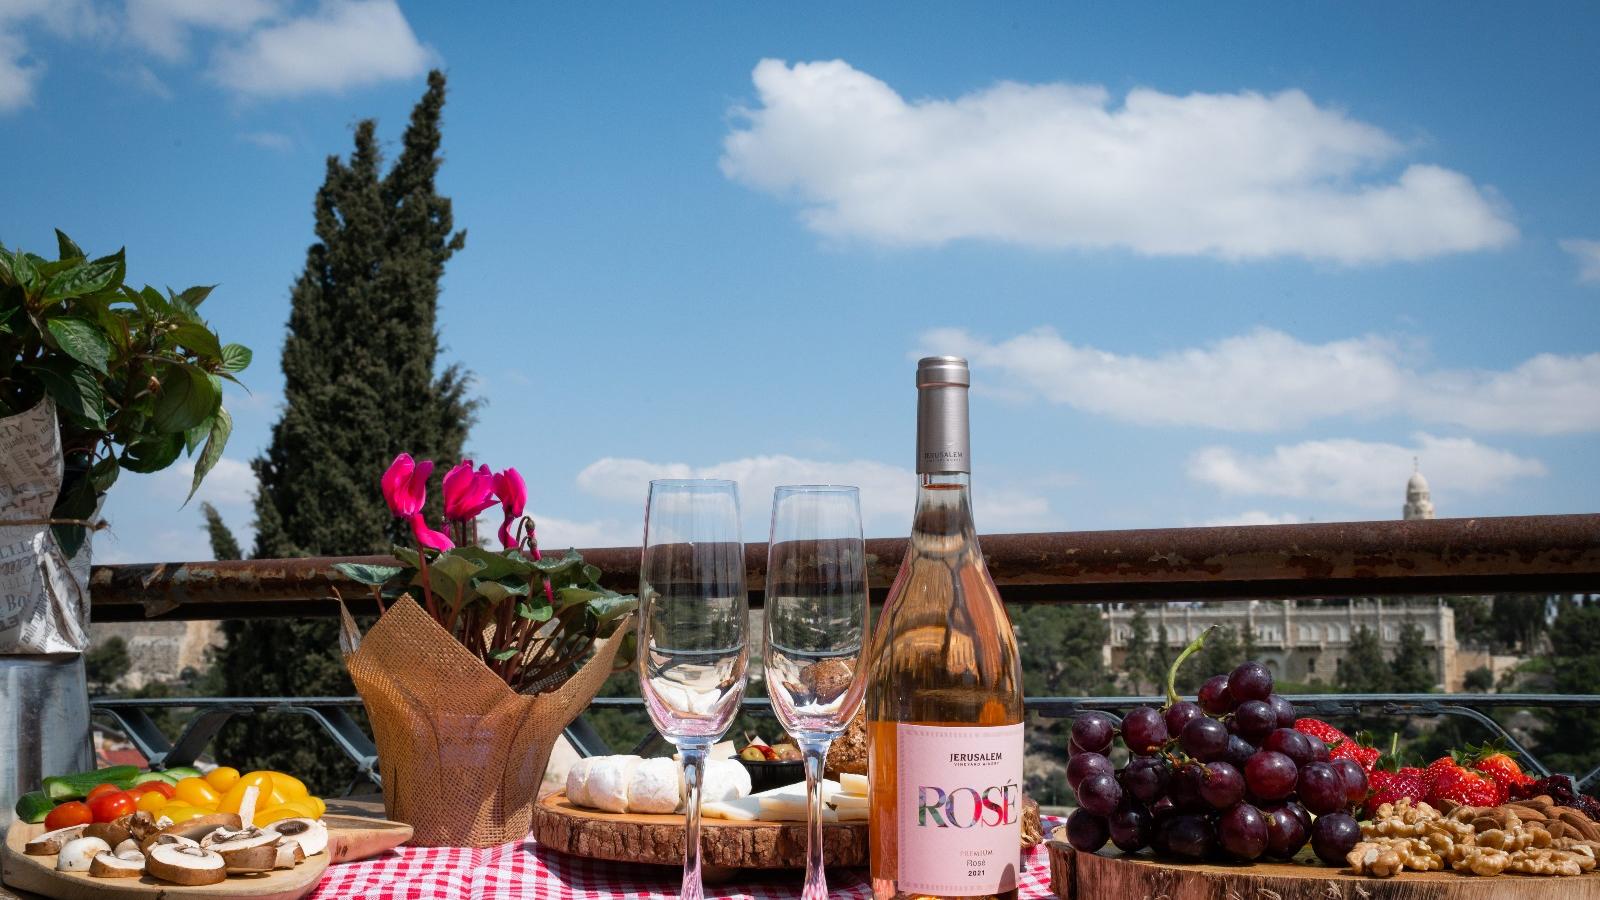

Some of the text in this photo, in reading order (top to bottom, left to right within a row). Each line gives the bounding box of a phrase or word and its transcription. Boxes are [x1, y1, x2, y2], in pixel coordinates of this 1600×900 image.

[949, 752, 1002, 762] JERUSALEM
[917, 779, 1018, 829] ROSÉ
[968, 869, 985, 877] 2021
